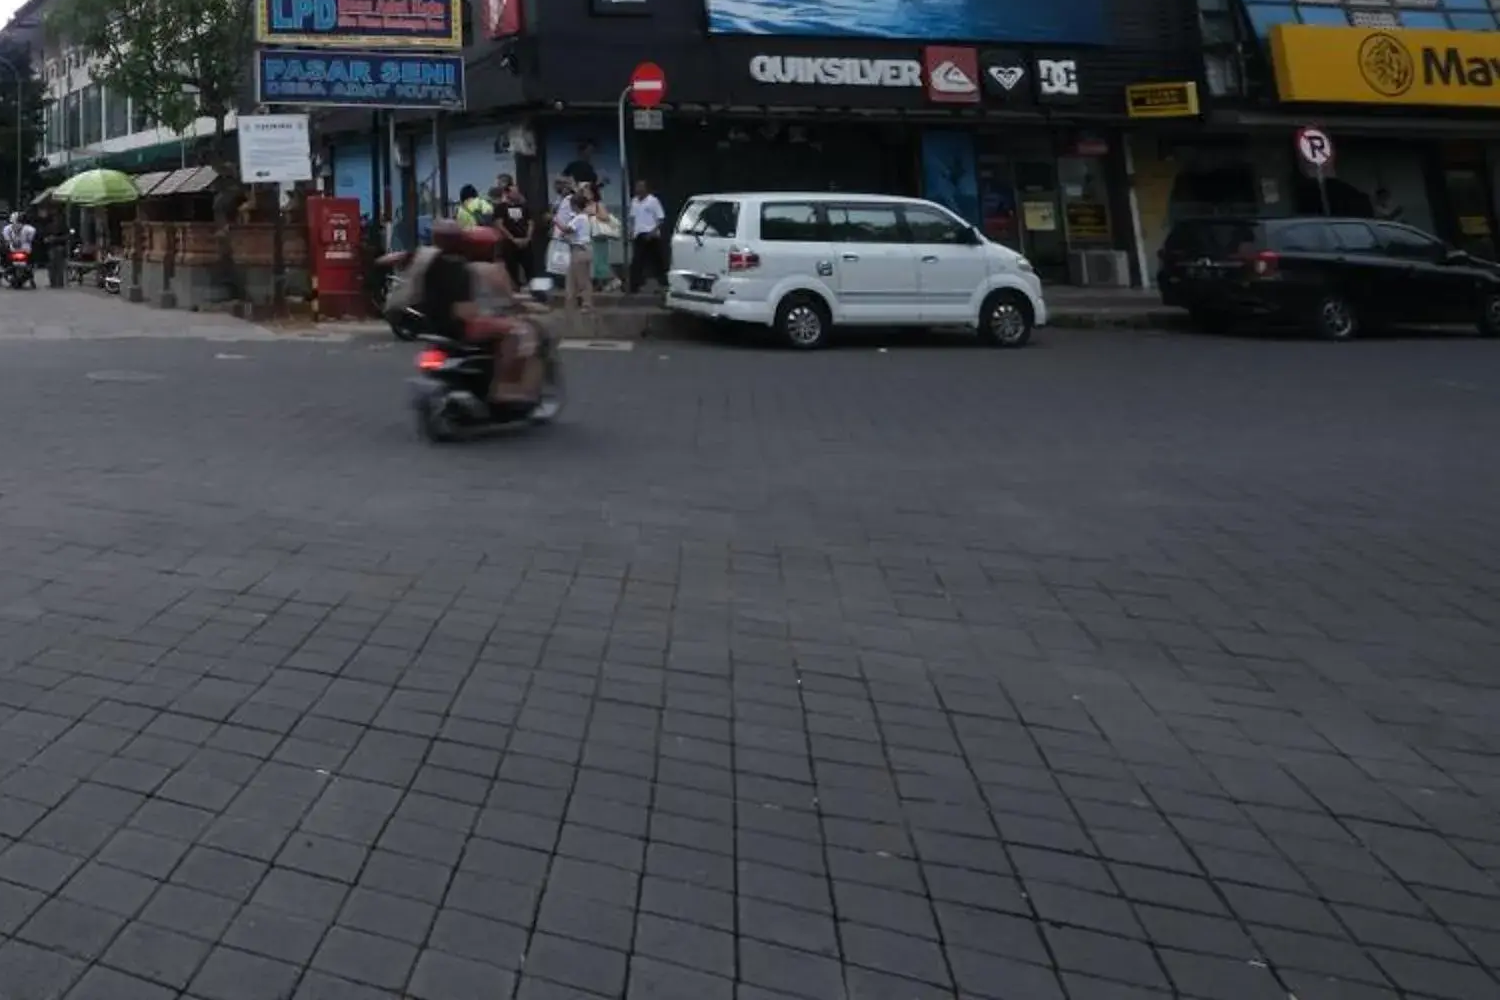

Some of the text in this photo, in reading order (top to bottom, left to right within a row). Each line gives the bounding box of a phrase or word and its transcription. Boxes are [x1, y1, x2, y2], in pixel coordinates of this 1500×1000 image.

[265, 58, 456, 84] PASAR SENI
[750, 55, 922, 87] QUIKSILVER
[1038, 60, 1078, 95] DC
[1422, 46, 1500, 87] Ma
